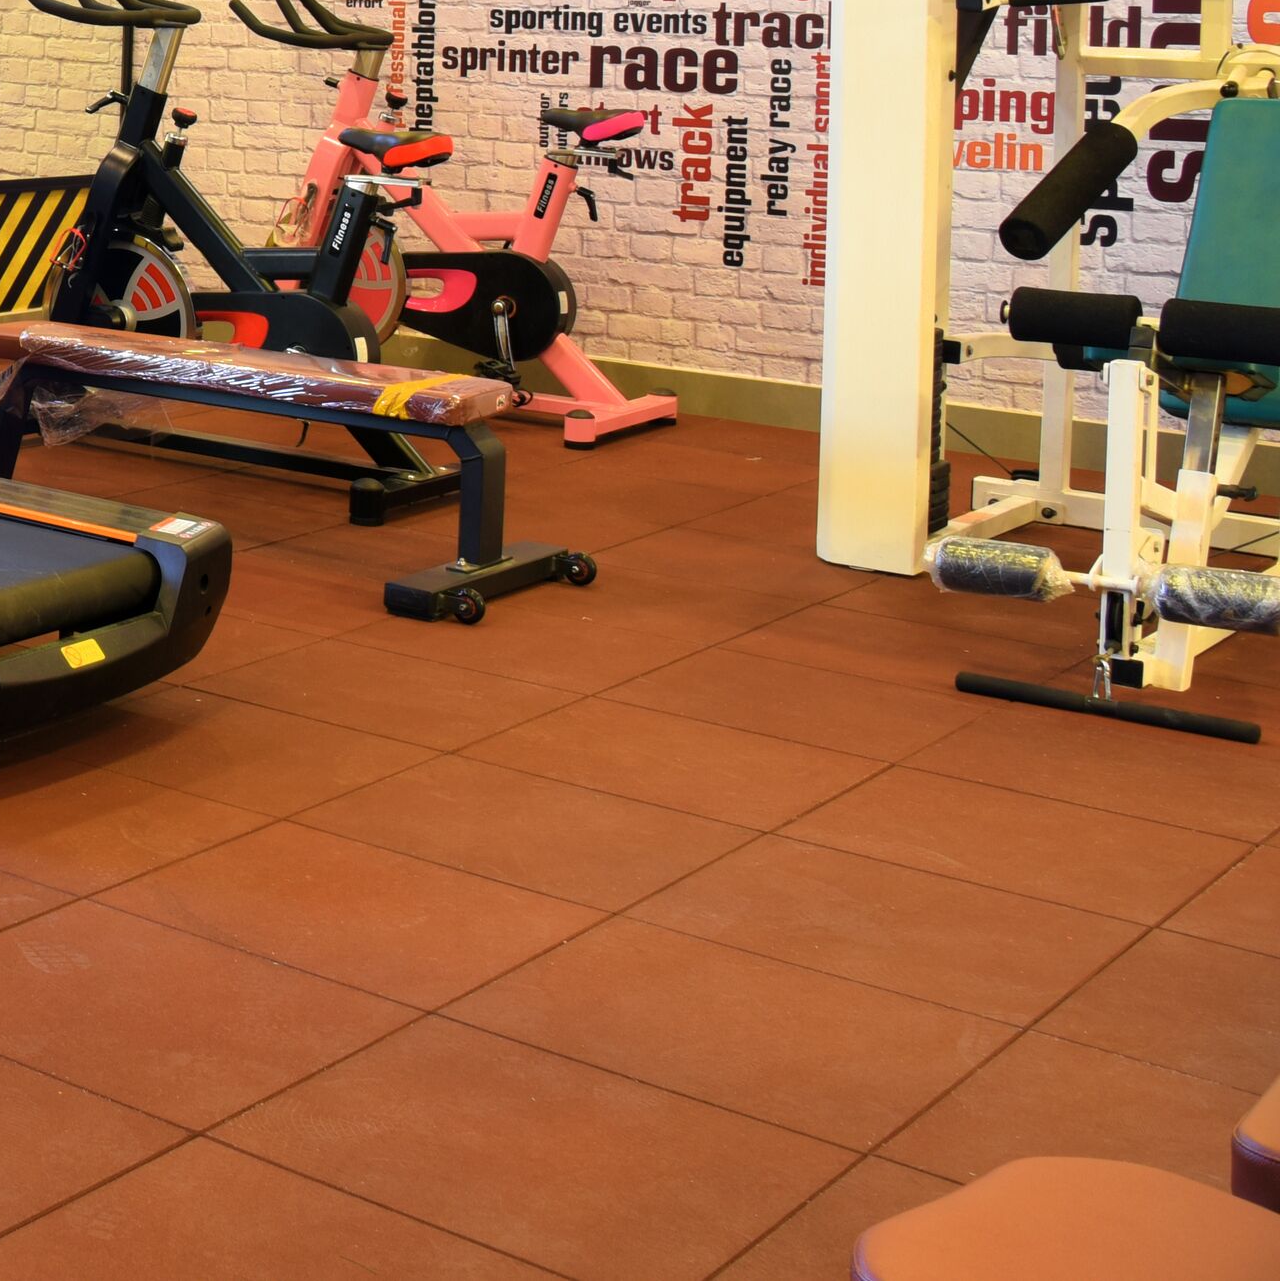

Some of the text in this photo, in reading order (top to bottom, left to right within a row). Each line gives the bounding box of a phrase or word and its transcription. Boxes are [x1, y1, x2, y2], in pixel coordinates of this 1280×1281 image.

[489, 4, 708, 37] sporting events
[441, 40, 580, 77] sprinter
[589, 44, 739, 95] race
[760, 58, 797, 216] relay race
[672, 103, 714, 223] track
[536, 177, 555, 214] Fitness
[717, 115, 752, 267] equipment
[331, 211, 352, 251] Fitness
